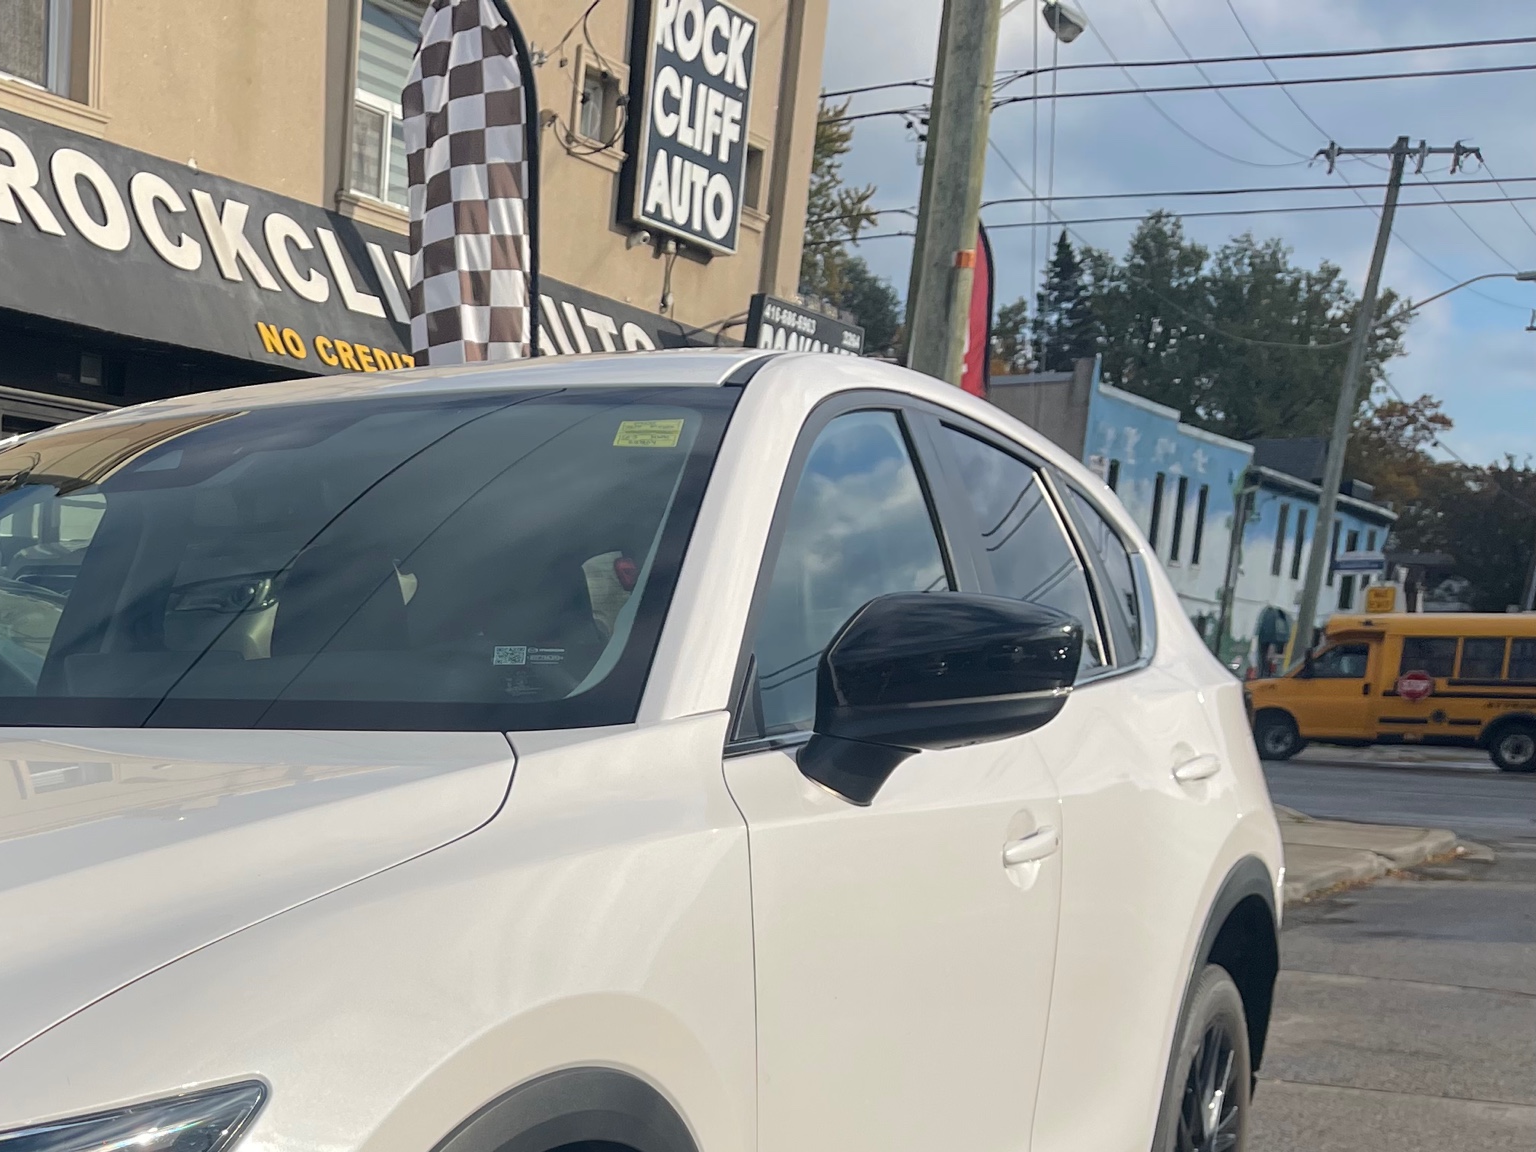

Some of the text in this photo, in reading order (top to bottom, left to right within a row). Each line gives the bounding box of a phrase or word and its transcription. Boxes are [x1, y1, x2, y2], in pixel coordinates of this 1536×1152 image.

[657, 0, 754, 90] ROCK
[653, 65, 743, 164] CLIFF
[645, 148, 734, 240] AUTO
[257, 321, 307, 360] NO
